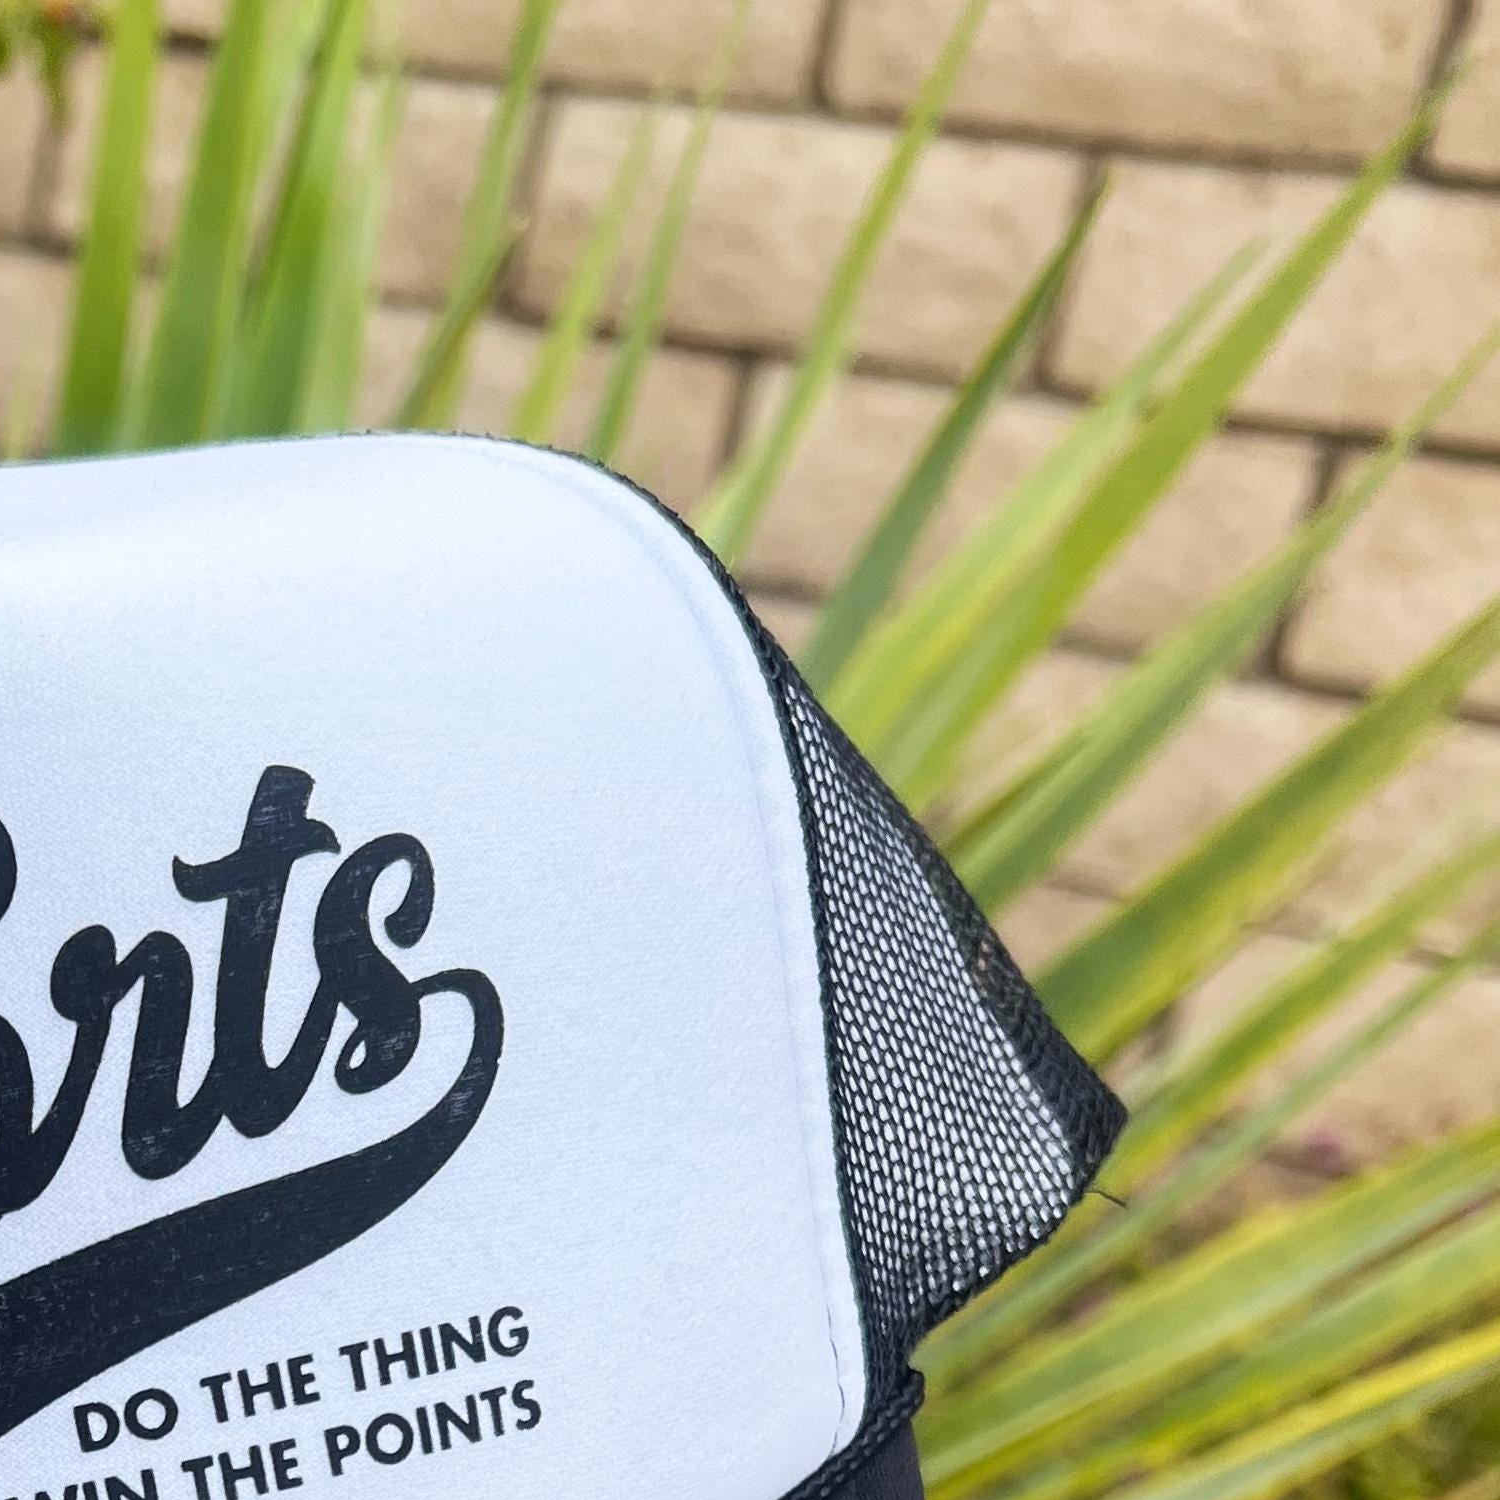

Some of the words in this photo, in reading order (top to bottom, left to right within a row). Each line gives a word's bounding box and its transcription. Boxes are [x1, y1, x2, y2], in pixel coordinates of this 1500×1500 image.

[74, 1387, 179, 1454] DO
[198, 1353, 321, 1424] THE
[338, 1305, 530, 1393] THING
[323, 1379, 542, 1477] POINTS
